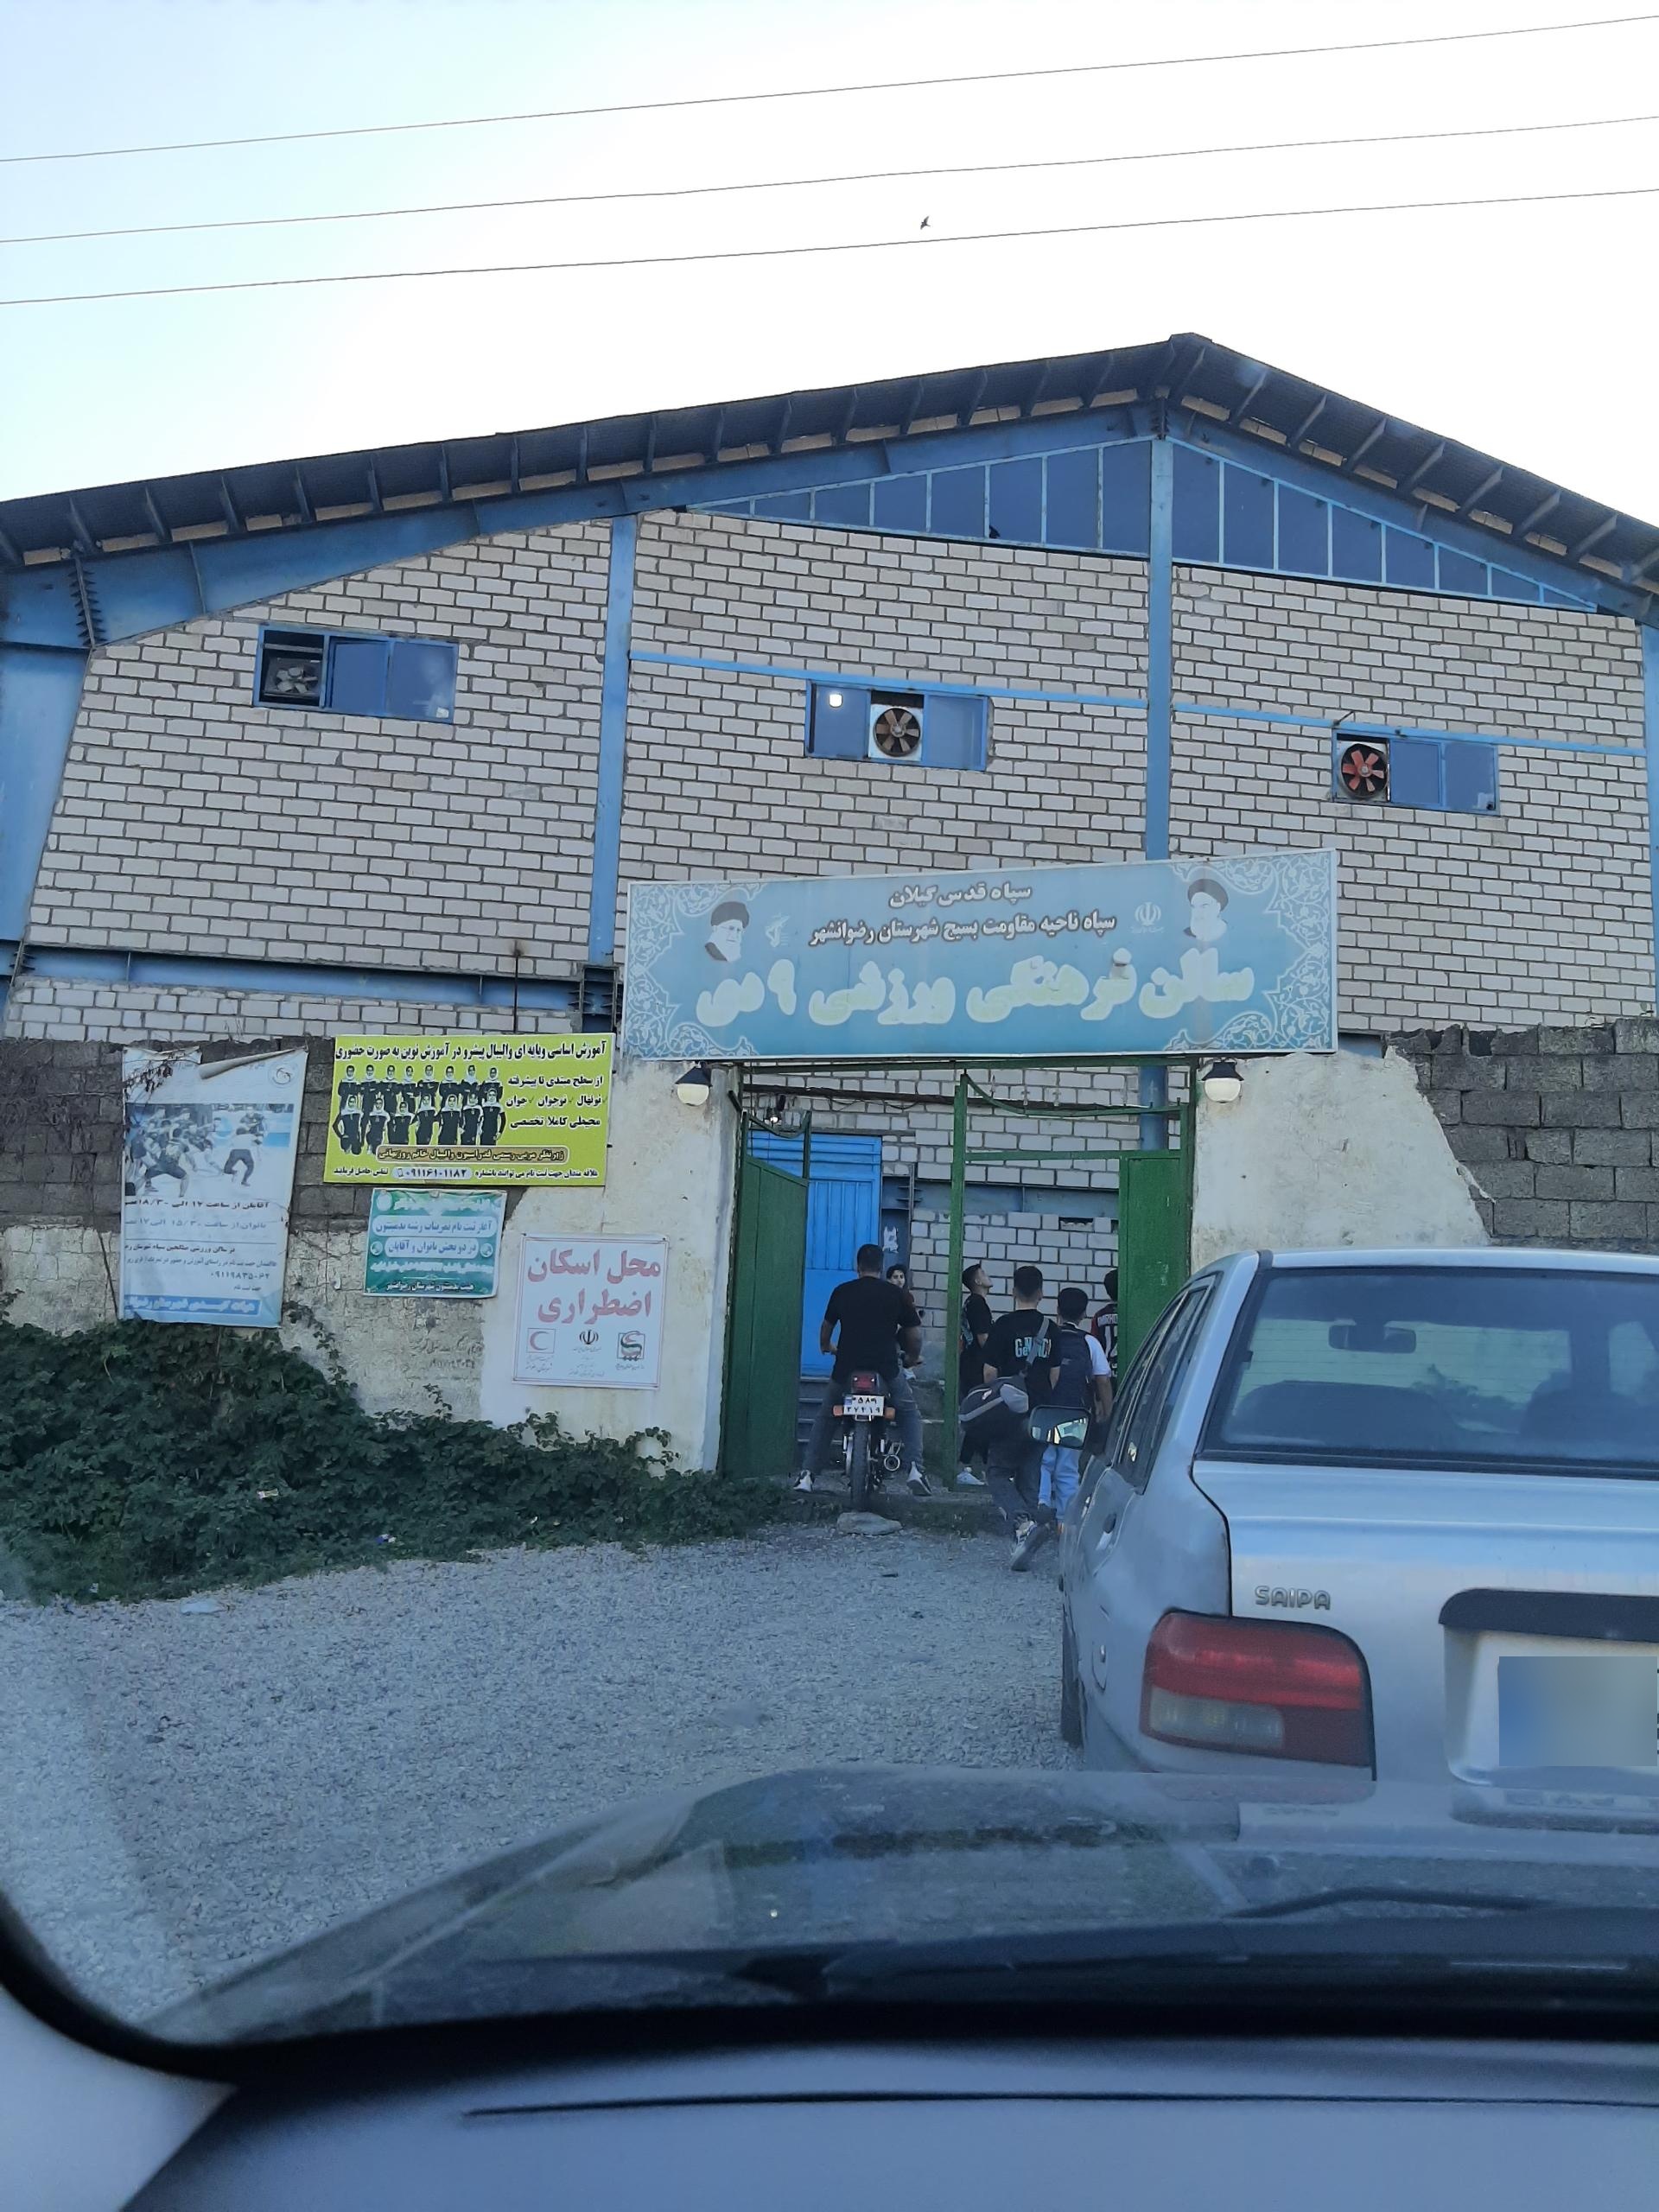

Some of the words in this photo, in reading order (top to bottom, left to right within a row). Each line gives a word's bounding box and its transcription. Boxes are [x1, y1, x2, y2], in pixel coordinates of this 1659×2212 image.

[888, 886, 938, 908] گیلان
[938, 882, 988, 907] قدس
[990, 882, 1032, 905] سپاه
[877, 917, 939, 944] شهرستان
[942, 920, 979, 942] بسیج
[982, 913, 1037, 940] مقاومت
[1039, 911, 1080, 936] ناحیه
[1083, 910, 1117, 936] سپاه
[809, 919, 874, 947] رضوانشهر
[767, 958, 797, 1015] ۹
[966, 948, 1137, 1023] فرهنگی
[1139, 948, 1255, 1019] سالن
[809, 961, 957, 1027] ورزشی
[335, 1044, 365, 1060] حضوری
[366, 1046, 390, 1060] صورت
[391, 1046, 400, 1059] به
[400, 1044, 419, 1060] نوین
[420, 1042, 450, 1060] آموزش
[451, 1046, 461, 1060] در
[486, 1042, 513, 1060] والیبال
[548, 1043, 575, 1059] اساسی
[575, 1040, 607, 1059] آموزش
[508, 1075, 537, 1088] پیشرفته
[538, 1075, 545, 1084] تا
[546, 1076, 570, 1087] مبتدی
[573, 1075, 593, 1087] سطح
[595, 1075, 603, 1087] از
[505, 1094, 527, 1107] جوان
[537, 1094, 567, 1107] نوجوان
[510, 1116, 544, 1128] تخصصی
[547, 1115, 568, 1127] کاملا
[569, 1115, 601, 1128] محیطی
[429, 1147, 455, 1160] والیبال
[493, 1150, 517, 1161] رسمی
[527, 1248, 601, 1282] اسکان
[607, 1249, 661, 1284] محل
[537, 1287, 652, 1325] اضطراری
[1255, 1585, 1331, 1611] SAIPA
